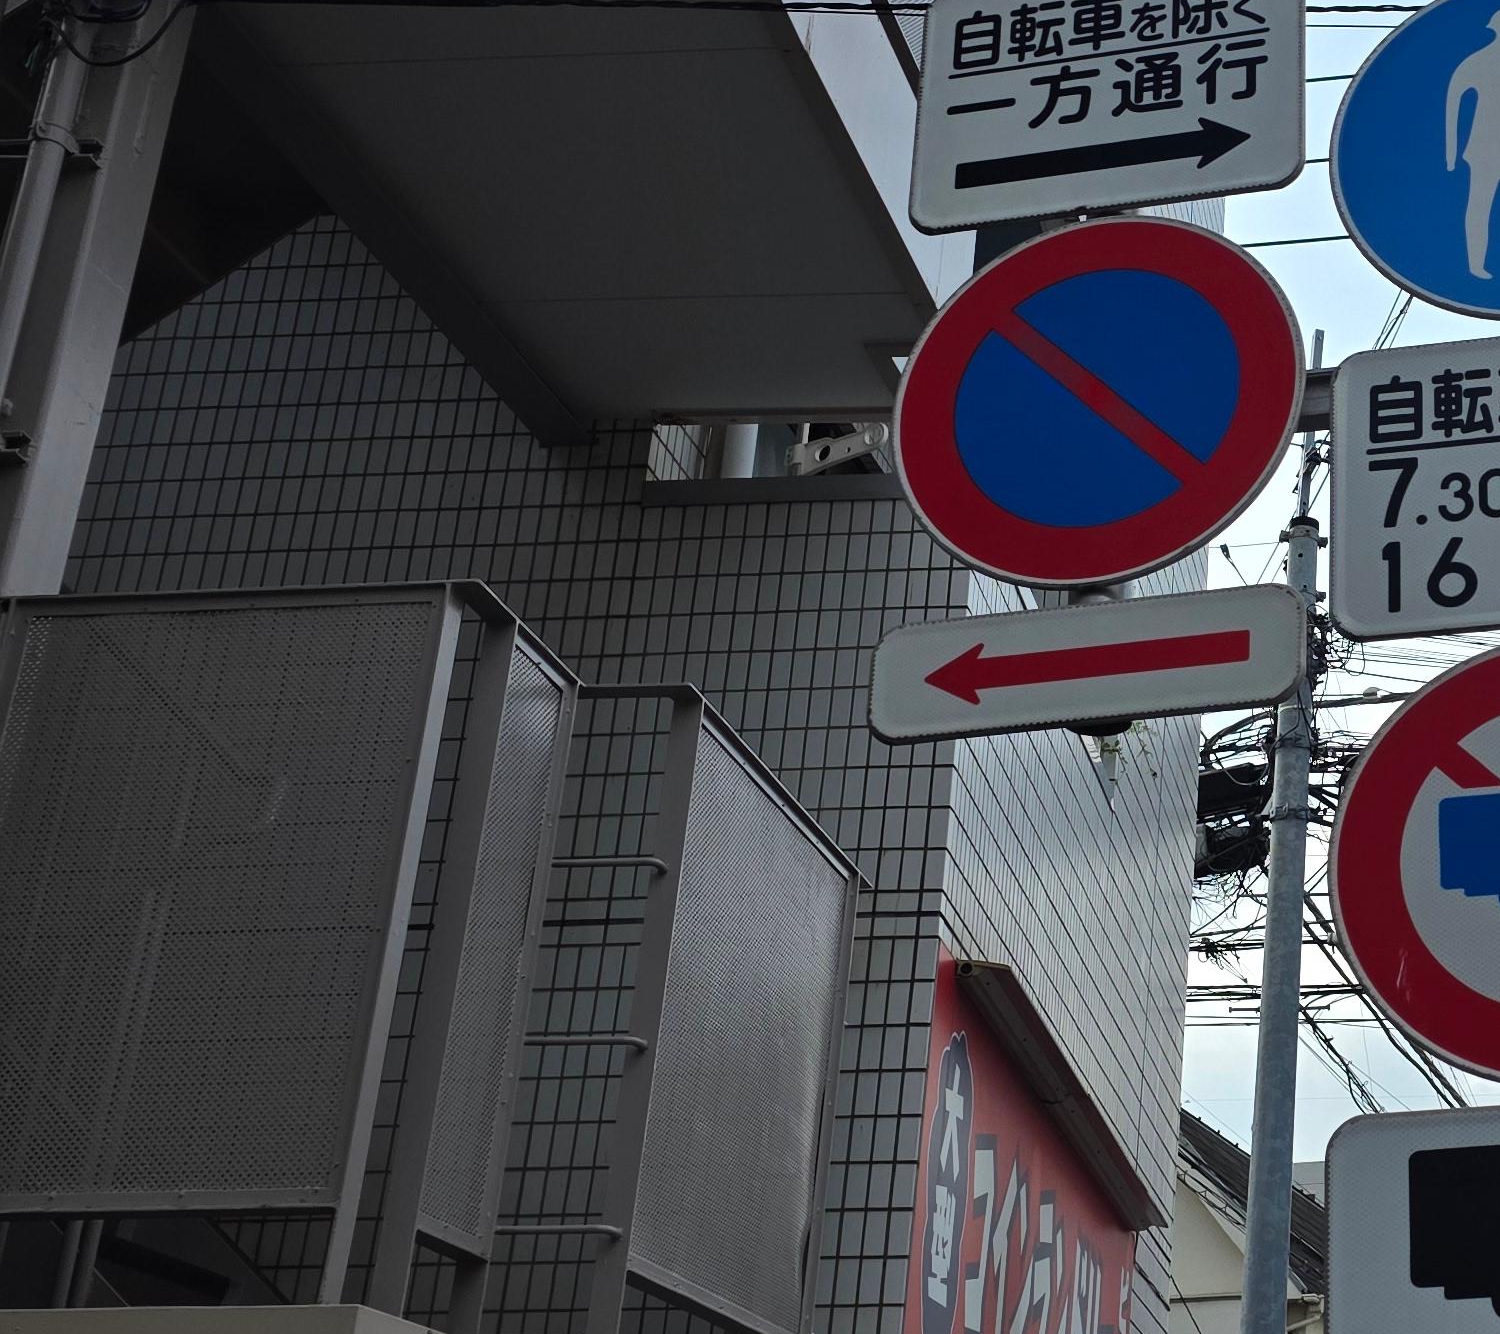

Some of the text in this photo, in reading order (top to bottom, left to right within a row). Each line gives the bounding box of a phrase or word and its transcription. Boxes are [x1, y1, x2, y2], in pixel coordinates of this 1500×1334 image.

[947, 38, 1267, 130] 一方通行
[927, 1063, 965, 1308] 大型
